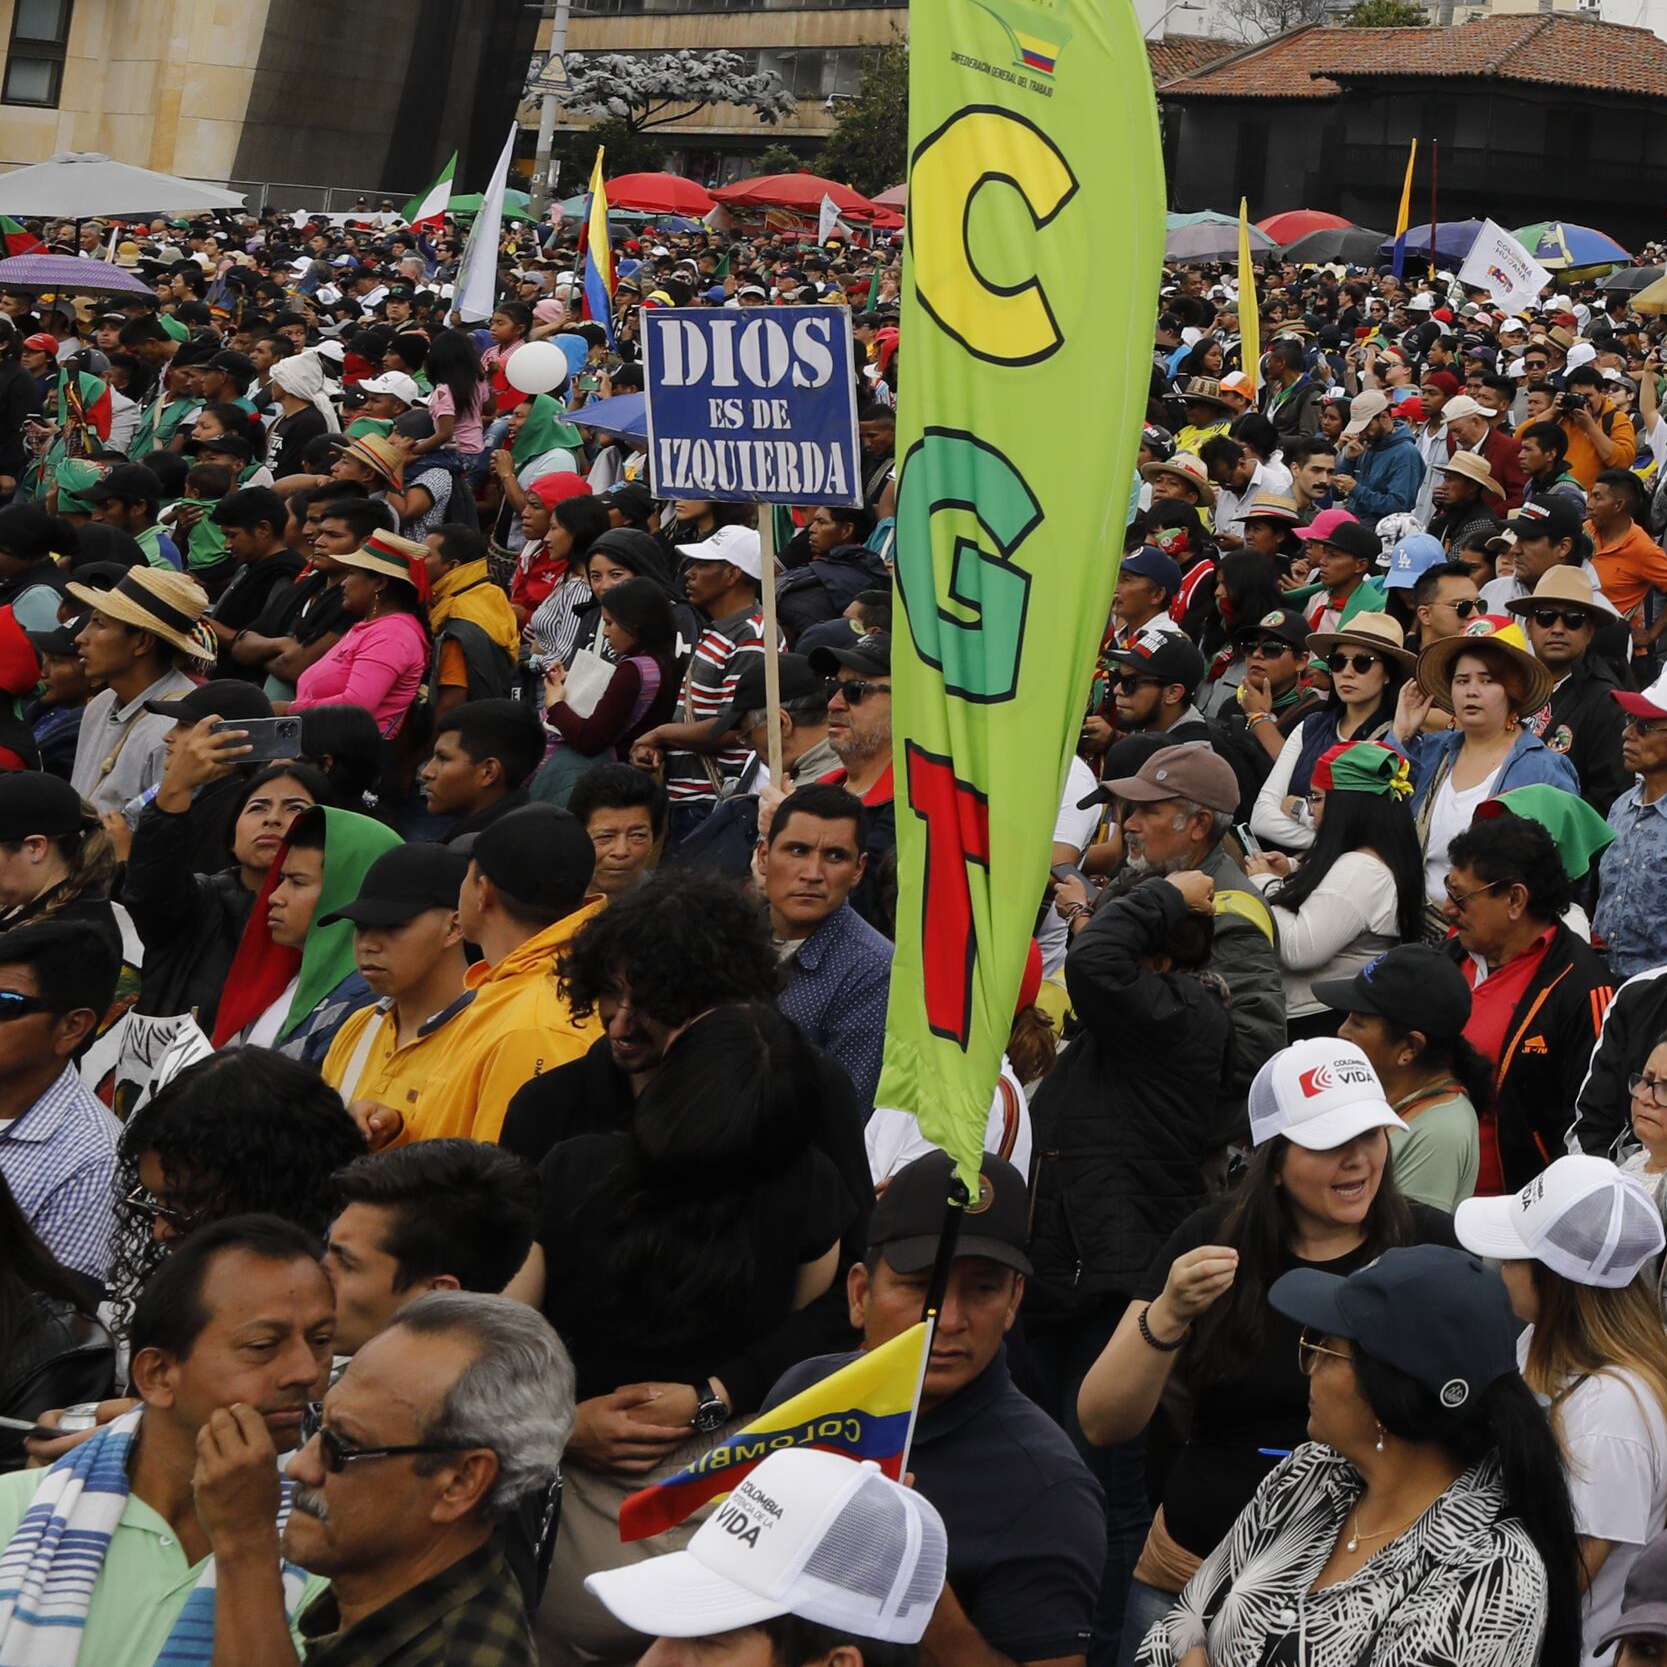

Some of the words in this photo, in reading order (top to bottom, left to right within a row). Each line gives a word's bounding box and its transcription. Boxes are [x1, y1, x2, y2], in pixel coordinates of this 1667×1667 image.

[656, 314, 835, 388] DIOS
[708, 398, 746, 430] ES
[752, 398, 793, 430] DE
[659, 437, 849, 495] IZQUIERDA
[1338, 1070, 1376, 1084] VIDA
[741, 1479, 784, 1521] COLOMBIA
[716, 1501, 760, 1548] VIDA
